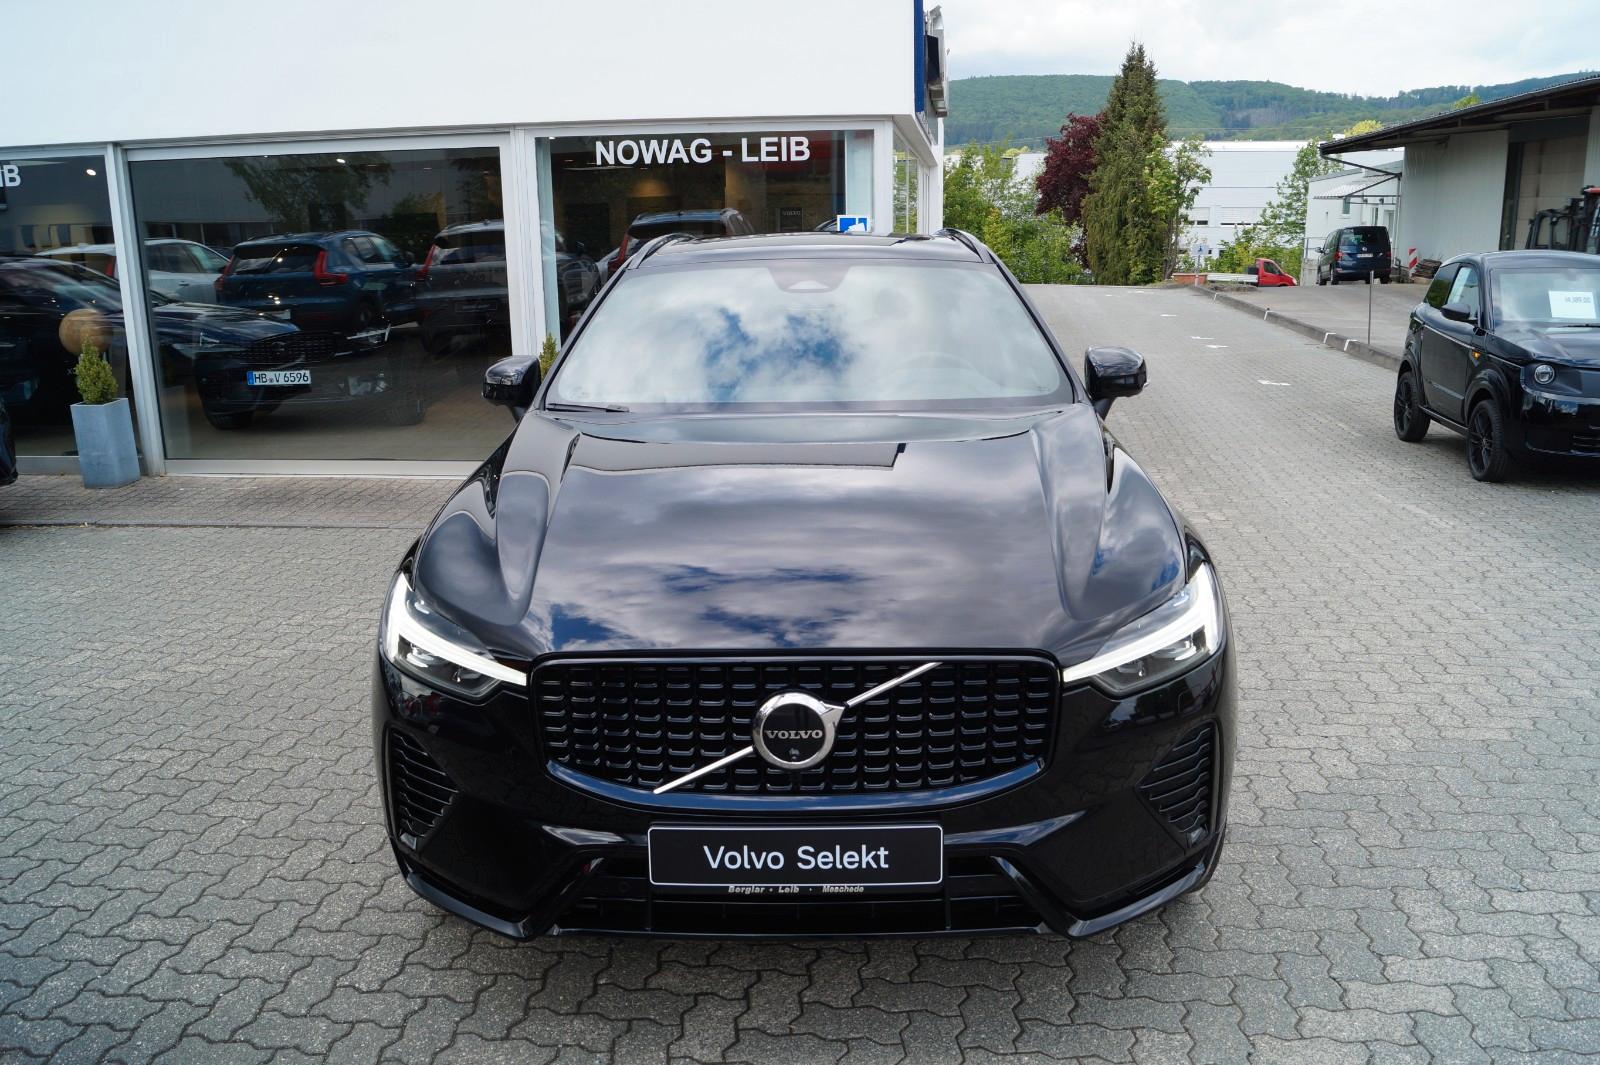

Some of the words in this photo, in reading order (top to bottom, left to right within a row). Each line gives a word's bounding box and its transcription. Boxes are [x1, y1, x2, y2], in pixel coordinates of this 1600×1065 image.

[595, 138, 712, 166] NOWAG
[741, 136, 811, 163] LEIB
[254, 373, 268, 384] HB
[283, 372, 309, 383] 6596
[765, 729, 824, 740] VOLVO
[703, 844, 785, 870] Volvo
[797, 844, 890, 870] Selekt
